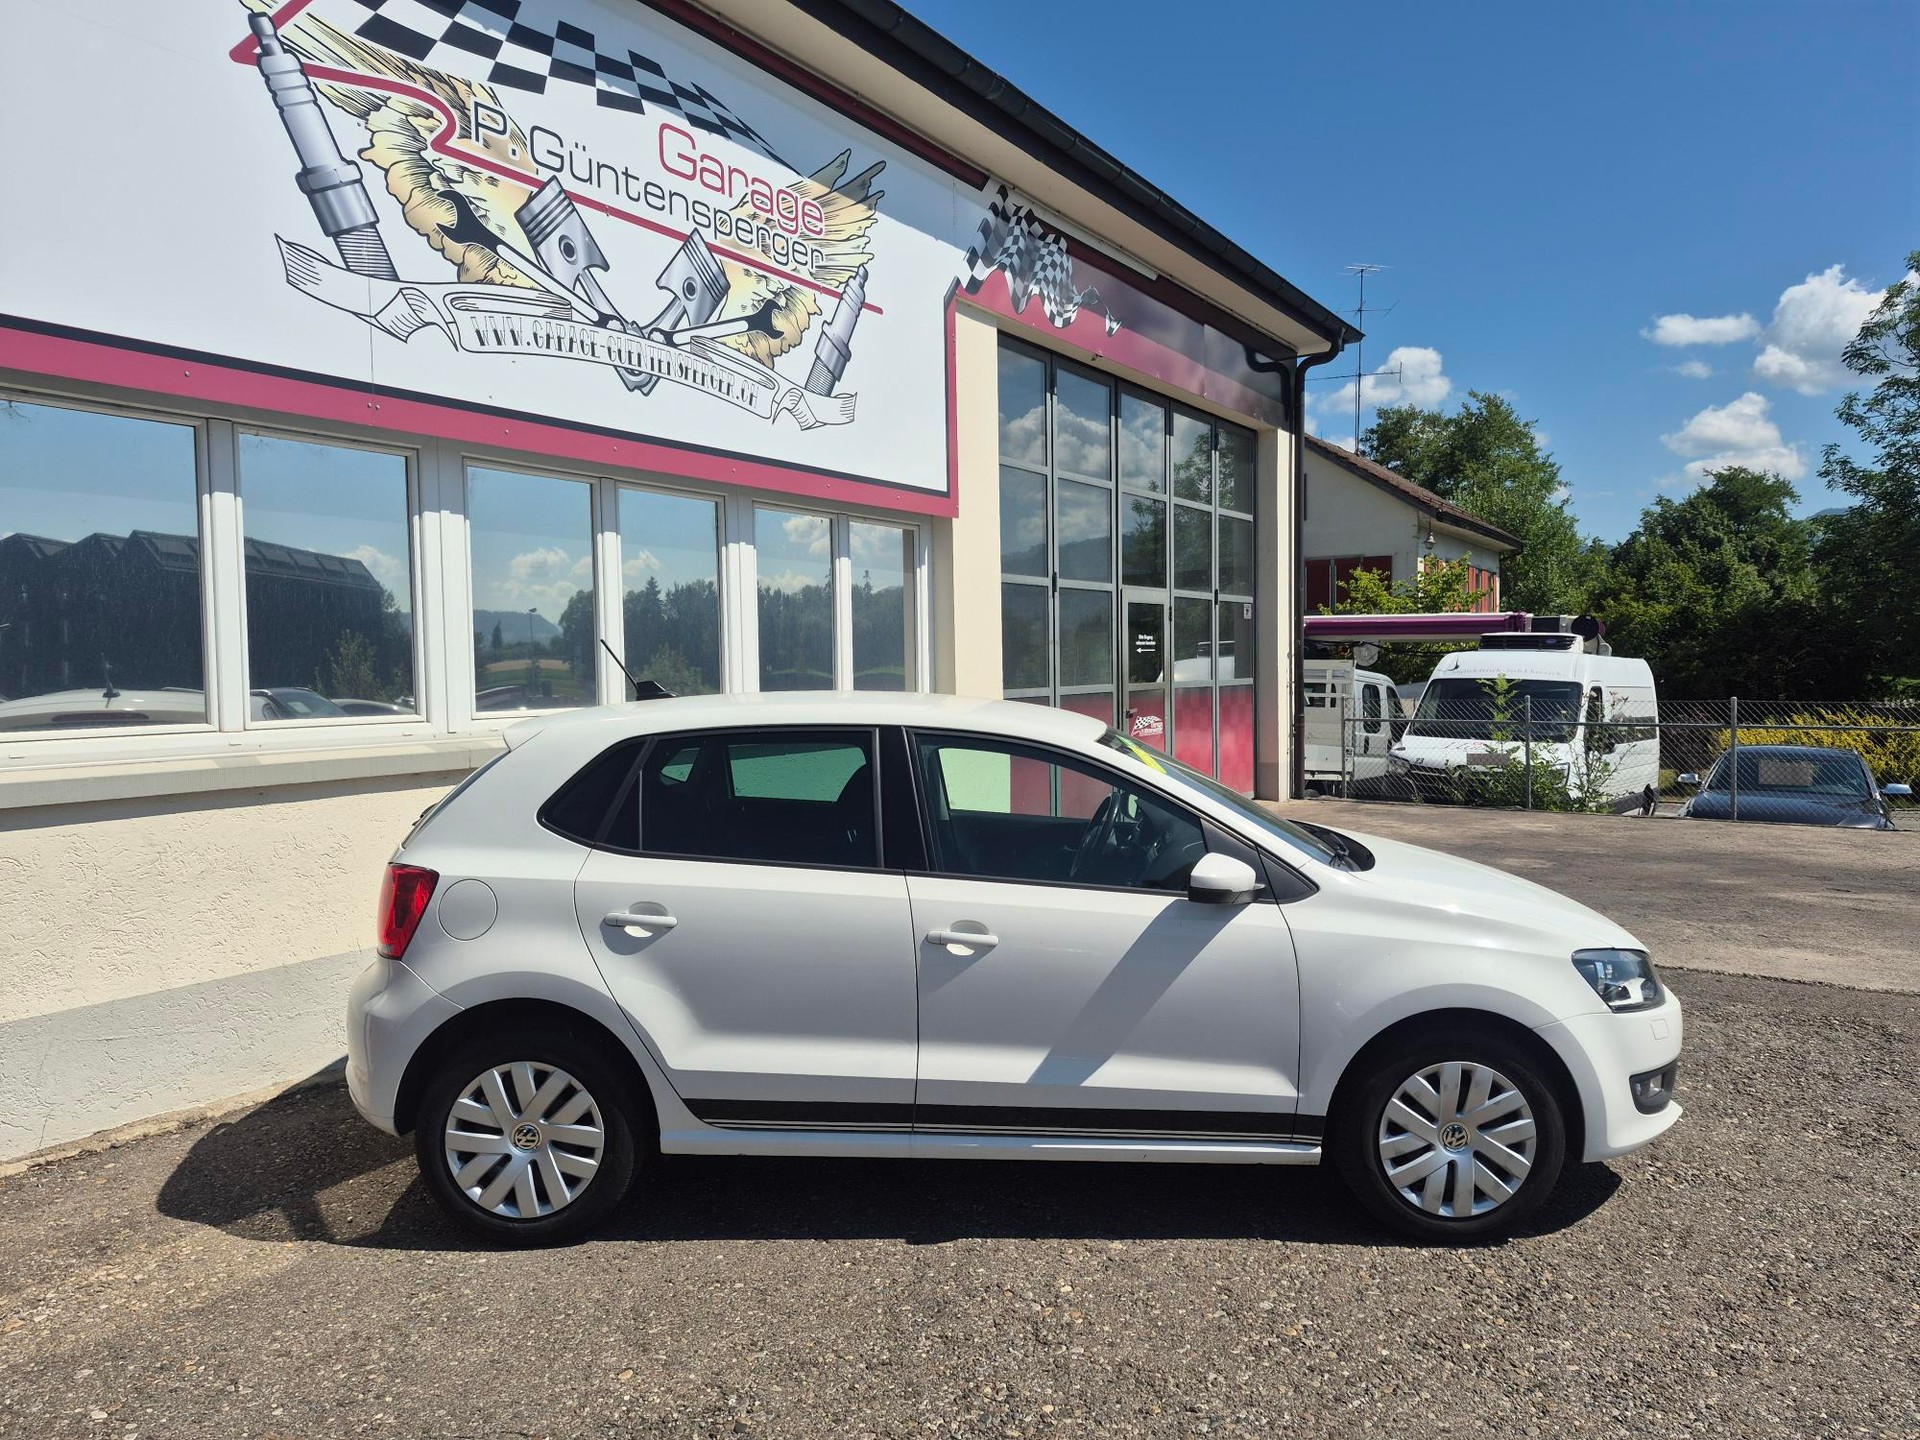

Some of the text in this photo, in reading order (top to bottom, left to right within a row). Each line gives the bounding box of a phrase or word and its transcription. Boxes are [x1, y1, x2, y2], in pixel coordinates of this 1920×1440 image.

[658, 122, 824, 236] Garage
[469, 315, 760, 409] WWW.GARAGE-GUENTENSPERGER.CH
[1443, 1124, 1468, 1149] VW
